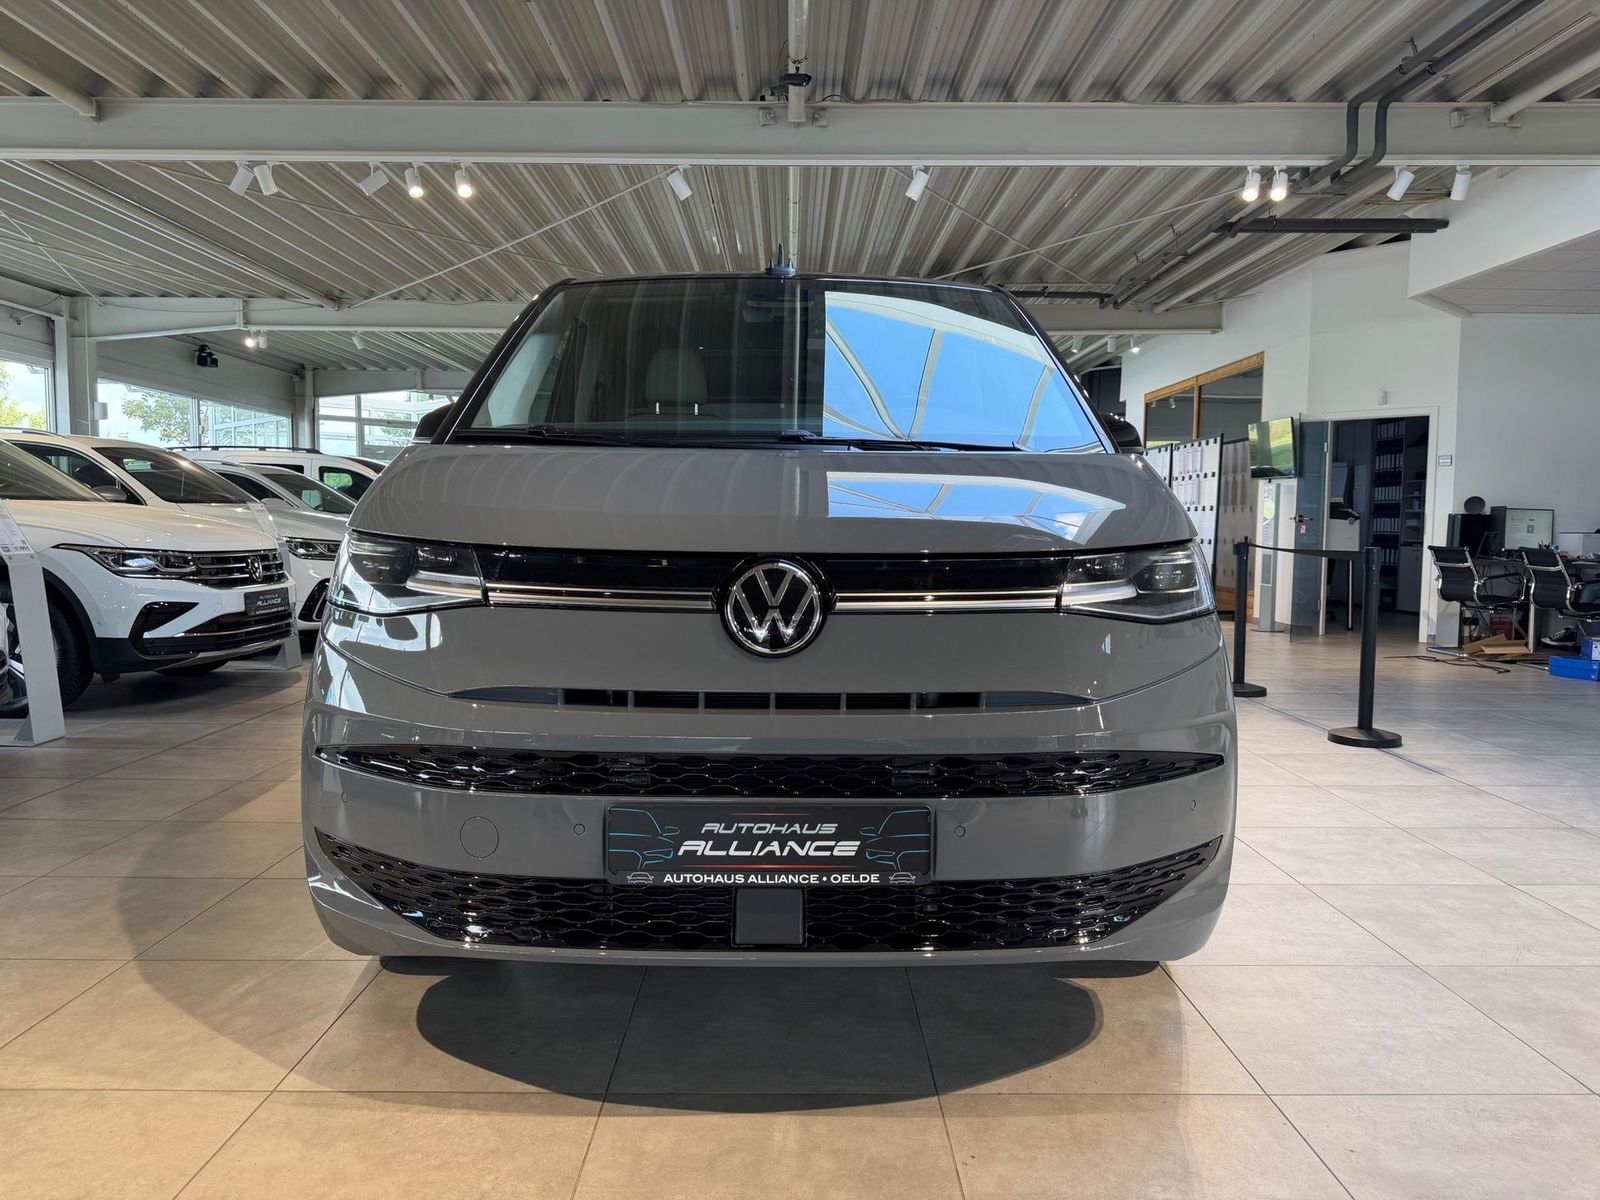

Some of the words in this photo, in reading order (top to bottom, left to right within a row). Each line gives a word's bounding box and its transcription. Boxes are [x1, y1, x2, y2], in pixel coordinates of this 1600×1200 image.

[701, 823, 838, 834] AUTOHAUS
[678, 840, 861, 856] ALLIANCE
[663, 873, 744, 883] AUTOHAUS
[747, 874, 819, 884] ALLIANCE
[830, 874, 880, 884] OELDE
